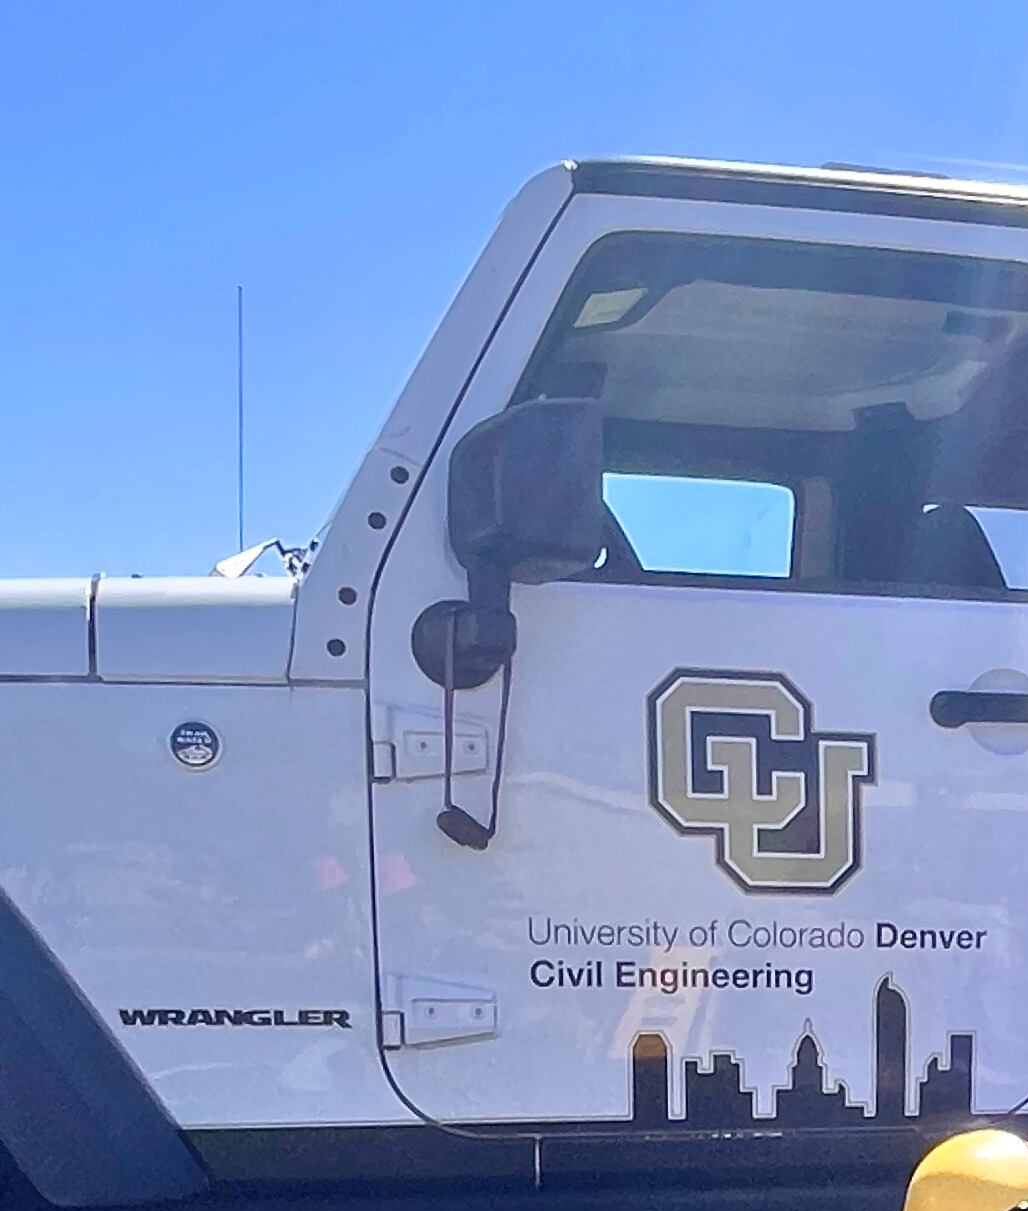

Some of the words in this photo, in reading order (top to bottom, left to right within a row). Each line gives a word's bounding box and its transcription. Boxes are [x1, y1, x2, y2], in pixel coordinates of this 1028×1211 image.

[646, 667, 877, 895] CU
[528, 917, 678, 953] University
[689, 920, 719, 946] of
[728, 920, 864, 948] Colorado
[876, 922, 988, 949] Denver
[530, 960, 602, 988] Civil
[616, 961, 814, 995] Engineering
[119, 1009, 352, 1028] WRANGLER
